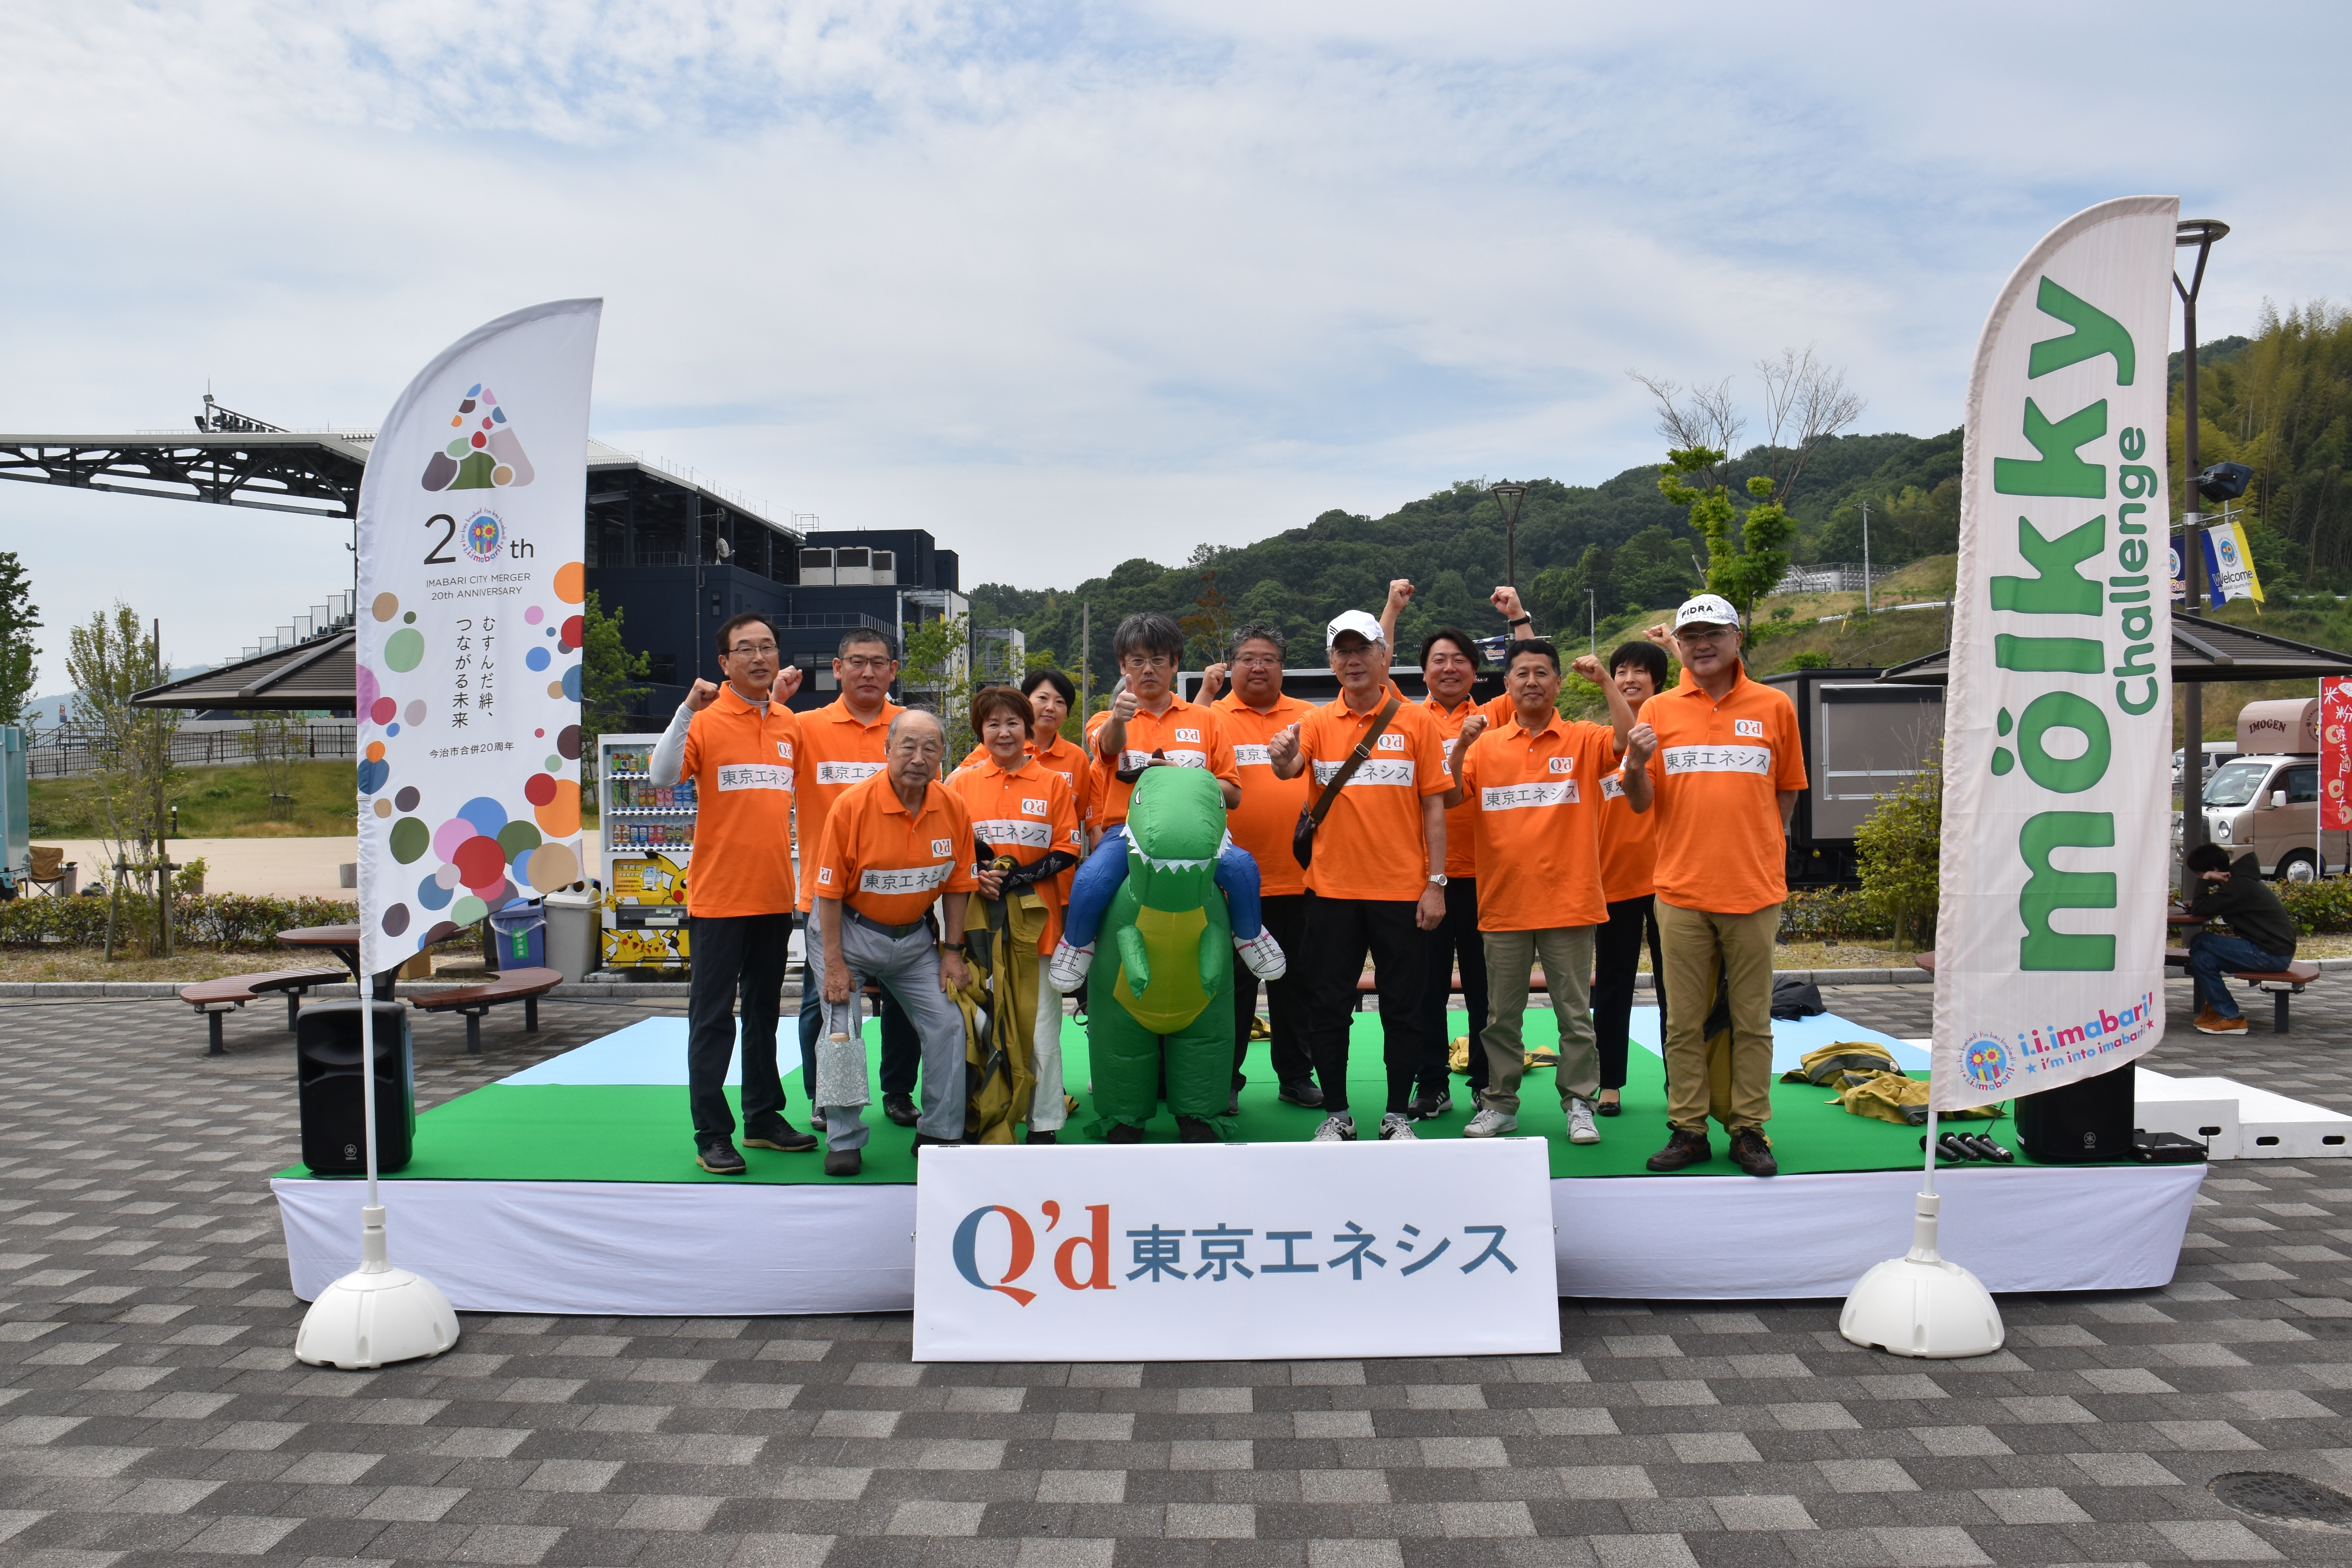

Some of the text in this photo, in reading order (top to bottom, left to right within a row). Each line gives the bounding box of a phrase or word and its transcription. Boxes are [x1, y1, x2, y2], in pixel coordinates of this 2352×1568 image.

[2109, 426, 2158, 715] Challenge
[2212, 570, 2253, 586] Welcome
[426, 573, 531, 588] IMABARI CITY MERGER
[432, 586, 523, 600] 20th ANNIVERSARY
[1682, 605, 1713, 618] FIDRA
[1990, 275, 2135, 971] mölkky
[452, 618, 472, 729] つながる未来
[479, 615, 496, 719] むすんだ絆、
[1737, 721, 1761, 735] Q'd
[2249, 719, 2287, 734] IMOGEN
[1176, 730, 1199, 741] Q'd
[1379, 735, 1403, 749] Q'd
[429, 741, 514, 759] 今治市合併20周年
[779, 744, 792, 757] Q'd
[1551, 759, 1572, 772] Q'd
[1666, 750, 1766, 769] 東京エネシス
[721, 769, 793, 786] 東京エネシ
[1486, 785, 1576, 806] 東京エネシス
[1023, 800, 1046, 813] Q'd
[975, 824, 1047, 843] 京エネシス
[933, 840, 951, 855] Q'd
[864, 867, 947, 889] 東京エネシ
[2018, 991, 2152, 1056] i.i.imabari!
[2041, 1024, 2146, 1070] i'm into imabari!
[953, 1200, 1519, 1308] Q'd 東京エネシス
